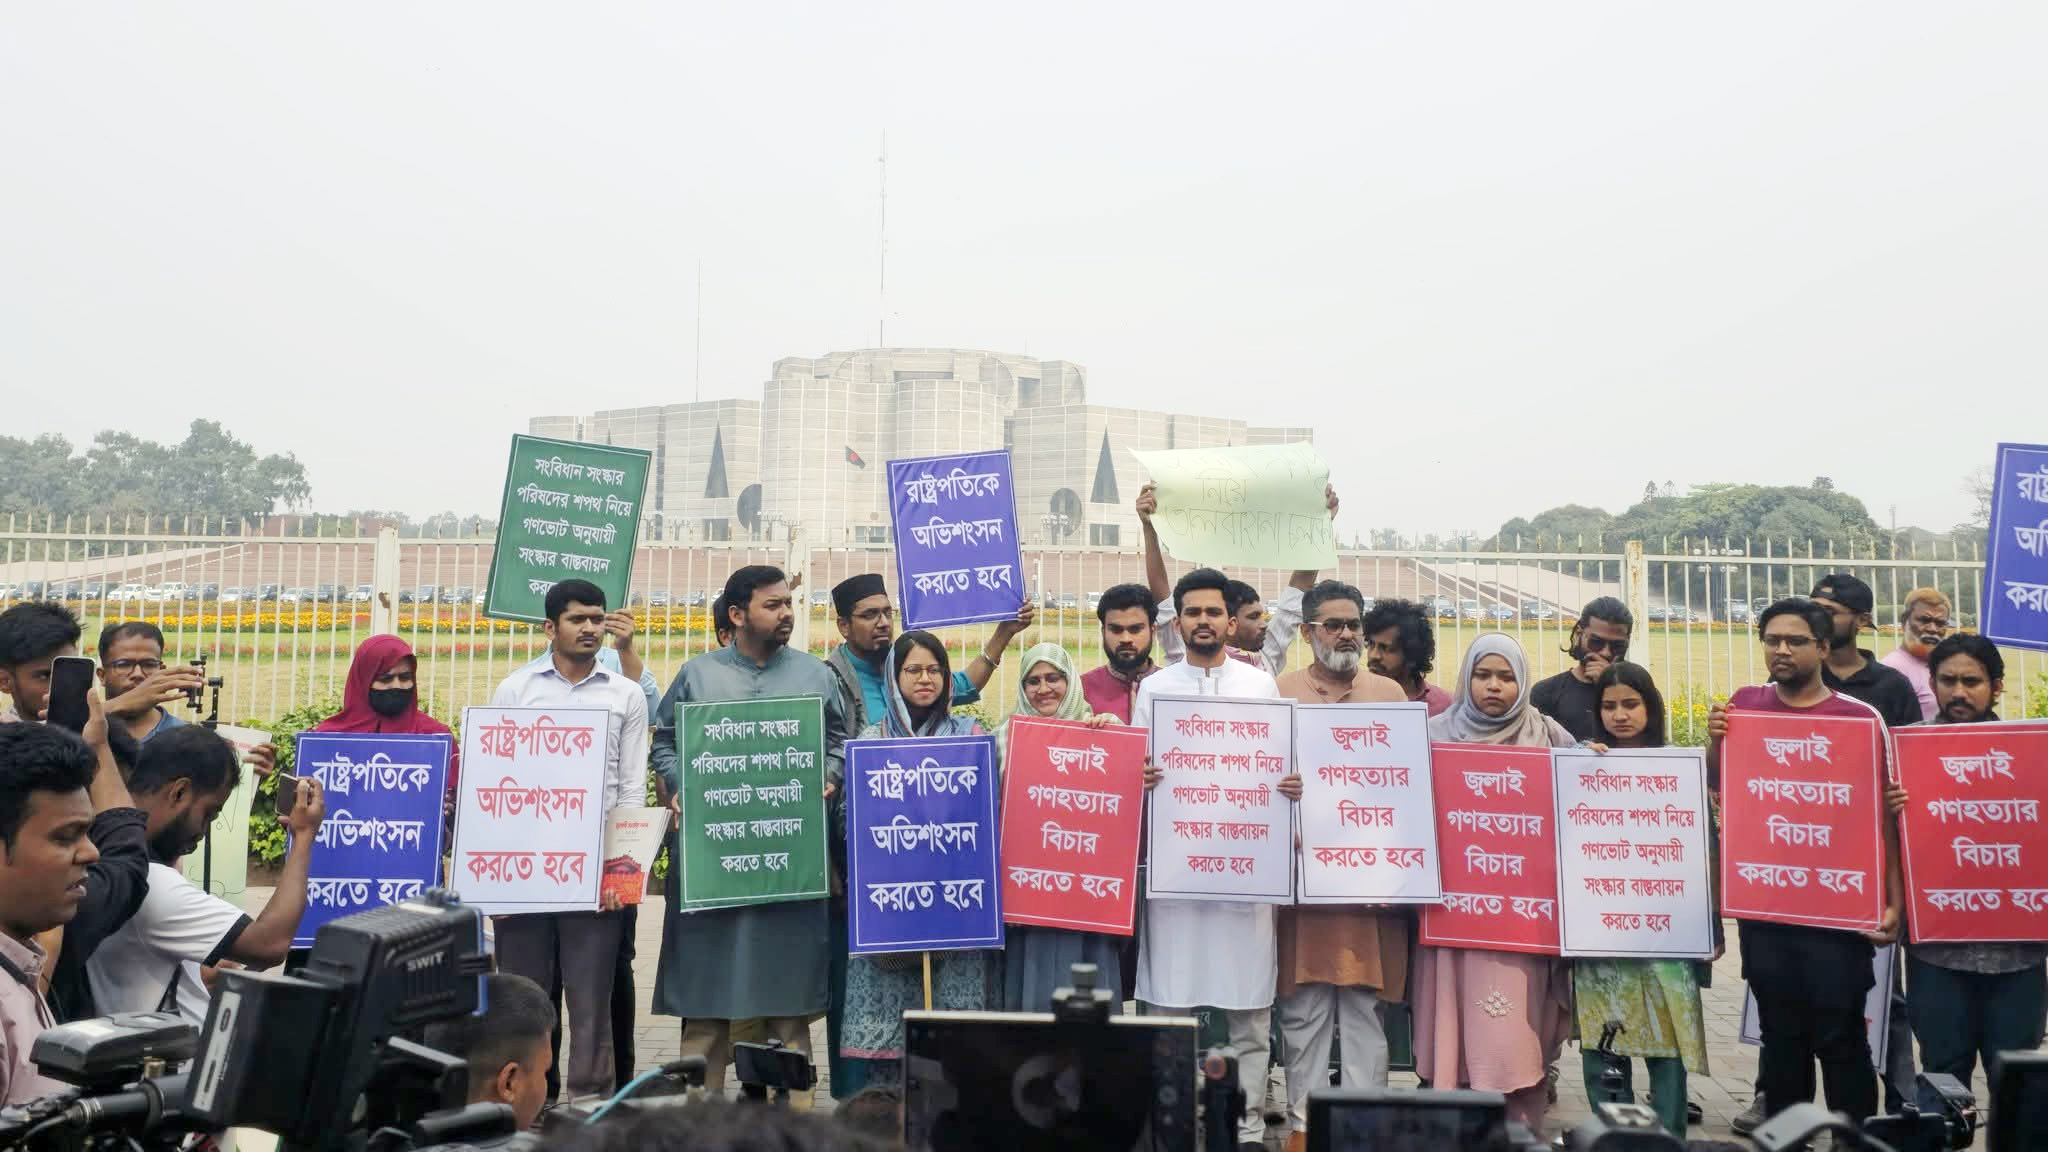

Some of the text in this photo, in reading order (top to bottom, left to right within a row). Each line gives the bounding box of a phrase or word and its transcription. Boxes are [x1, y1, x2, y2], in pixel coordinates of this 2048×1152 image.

[535, 456, 625, 486] সংবিধান সংস্কার
[517, 482, 633, 517] পরিষদের শপথ নিয়ে
[904, 468, 1000, 505] রাষ্ট্রপতিকে
[523, 517, 616, 546] গণভোট অনুযায়ী
[911, 516, 1003, 550] অভিশংসন
[519, 547, 610, 574] সংস্কার বাস্তবায়ন
[912, 565, 1012, 597] করতে হবে
[479, 715, 595, 761] রাষ্ট্রপতিকে
[704, 717, 800, 742] সংবিধান সংস্কার
[1175, 714, 1269, 740] সংবিধান সংস্কার
[1330, 721, 1390, 752] জুলাই
[691, 747, 815, 774] পরিষদের শপথ নিয়ে
[1048, 744, 1109, 774] জুলাই
[1161, 747, 1284, 774] পরিষদের শপথ নিয়ে
[1763, 732, 1832, 767] জুলাই
[312, 752, 432, 796] রাষ্ট্রপতিকে
[865, 757, 979, 802] রাষ্ট্রপতিকে
[1318, 765, 1410, 787] গণহত্যার
[1939, 748, 2014, 784] জুলাই
[704, 779, 803, 808] গণভোট অনুযায়ী
[1462, 767, 1527, 798] জুলাই
[1579, 769, 1679, 794] সংবিধান সংস্কার
[1747, 777, 1852, 807] গণহত্যার
[476, 777, 588, 822] অভিশংসন
[1027, 785, 1122, 816] গণহত্যার
[1173, 783, 1271, 811] গণভোট অনুযায়ী
[1927, 798, 2040, 824] গণহত্যার
[1337, 800, 1395, 828] বিচার
[1447, 809, 1544, 838] গণহত্যার
[1568, 803, 1696, 828] পরিষদের শপথ নিয়ে
[704, 818, 803, 842] সংস্কার বাস্তবায়ন
[870, 815, 978, 855] অভিশংসন
[1041, 821, 1099, 855] বিচার
[1173, 821, 1270, 842] সংস্কার বাস্তবায়ন
[1766, 815, 1832, 848] বিচার
[720, 853, 789, 872] করতে হবে
[1187, 855, 1255, 875] করতে হবে
[1312, 847, 1426, 869] করতে হবে
[1464, 845, 1525, 876] বিচার
[1581, 838, 1684, 865] গণভোট অনুযায়ী
[1952, 836, 2022, 867] বিচার
[466, 851, 587, 886] করতে হবে
[1008, 866, 1124, 900] করতে হবে
[1735, 862, 1866, 895] করতে হবে
[867, 879, 985, 912] করতে হবে
[1584, 878, 1684, 897] সংস্কার বাস্তবায়ন
[1923, 889, 2004, 912] করতে
[1442, 892, 1554, 920] করতে হবে
[1600, 913, 1672, 933] করতে হবে
[407, 952, 445, 972] SWIT
